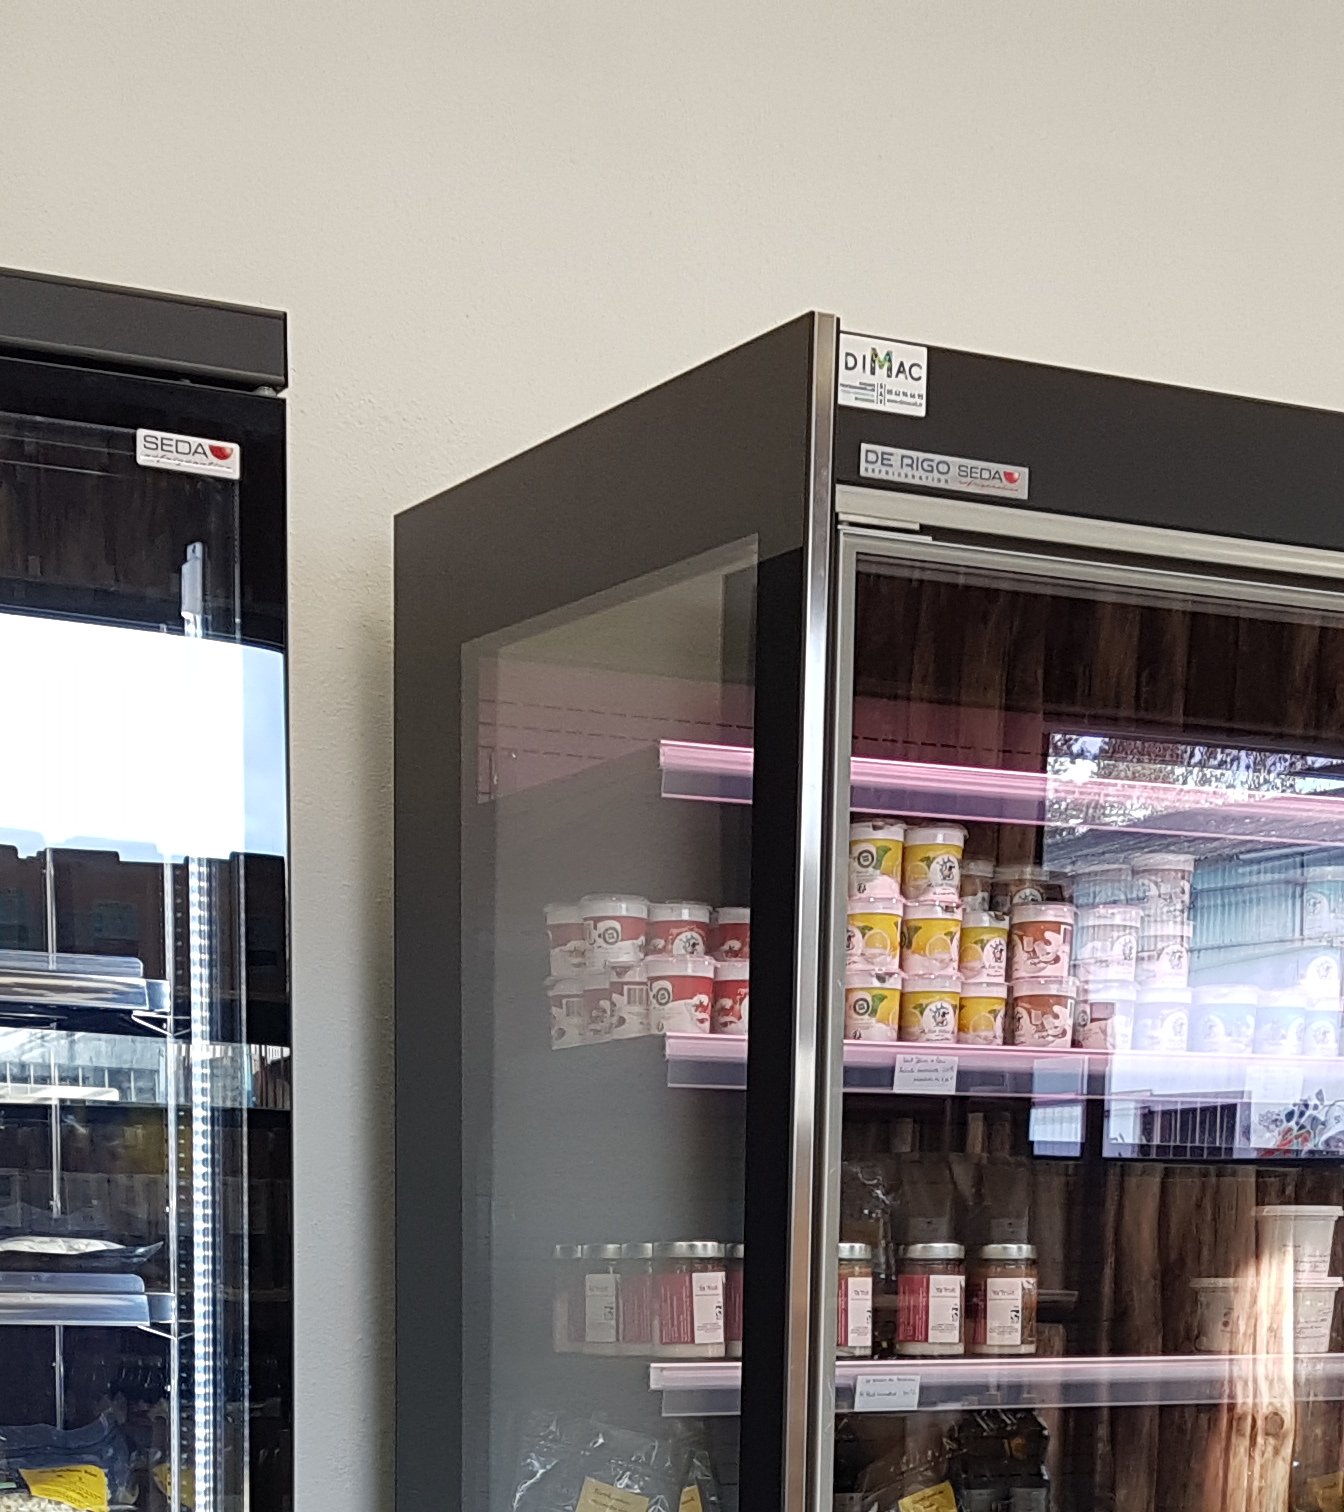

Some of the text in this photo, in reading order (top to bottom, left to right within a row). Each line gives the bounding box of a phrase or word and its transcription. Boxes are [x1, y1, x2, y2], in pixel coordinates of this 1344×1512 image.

[844, 347, 923, 381] DIMAC
[143, 434, 208, 458] SEDA
[864, 449, 951, 475] DE RIGO
[958, 465, 1003, 483] SEDA
